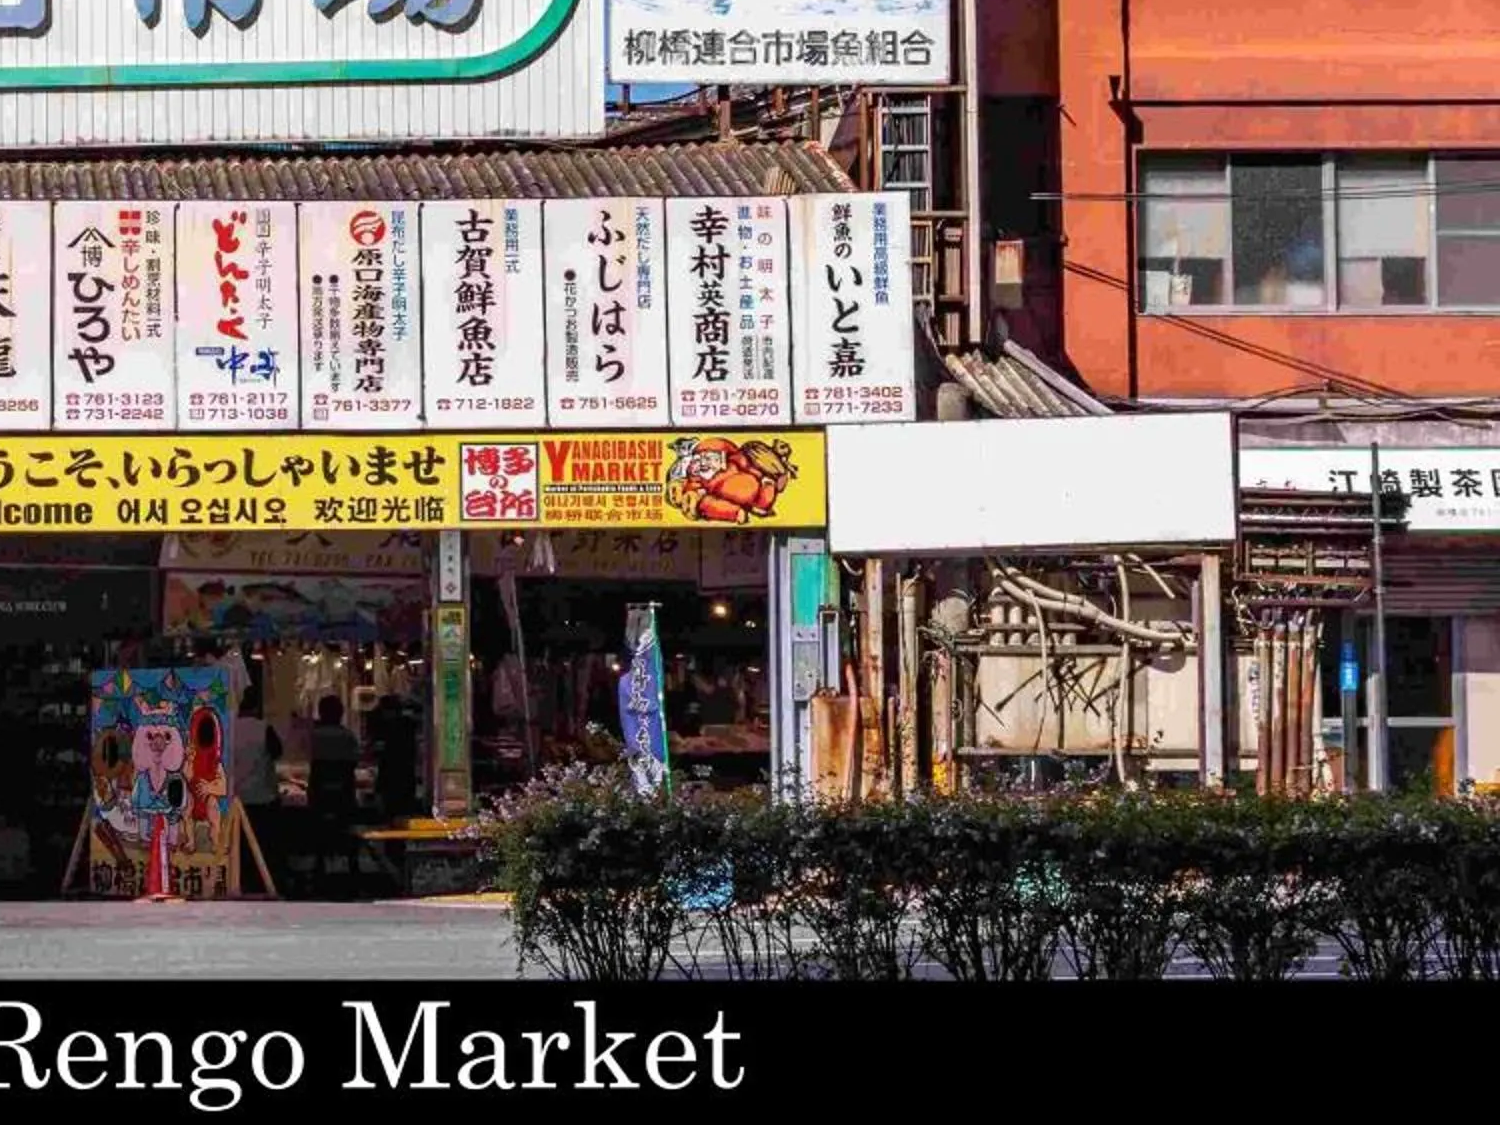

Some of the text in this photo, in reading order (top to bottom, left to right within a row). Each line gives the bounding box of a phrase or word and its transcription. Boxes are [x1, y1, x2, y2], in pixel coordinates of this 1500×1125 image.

[624, 28, 935, 67] 柳橋連合市場魚組合
[757, 205, 775, 330] 味の明太子
[455, 208, 497, 387] 古賀鮮魚店
[588, 210, 627, 383] ふじはら
[690, 205, 731, 382] 幸村英商店
[67, 272, 116, 383] ひろや
[352, 248, 386, 392] 原口海産物専門店
[84, 408, 165, 420] 731-2242
[332, 398, 411, 411] 761-3377
[456, 397, 534, 410] 712-1822
[700, 404, 780, 416] 712-0270
[464, 447, 535, 476] 博多
[543, 440, 663, 483] YANAGIBASHI
[572, 462, 663, 482] MARKET
[488, 475, 509, 489] の
[117, 498, 288, 525] 어서 오십시오
[313, 496, 446, 524] 欢迎光临
[464, 490, 536, 519] 台所
